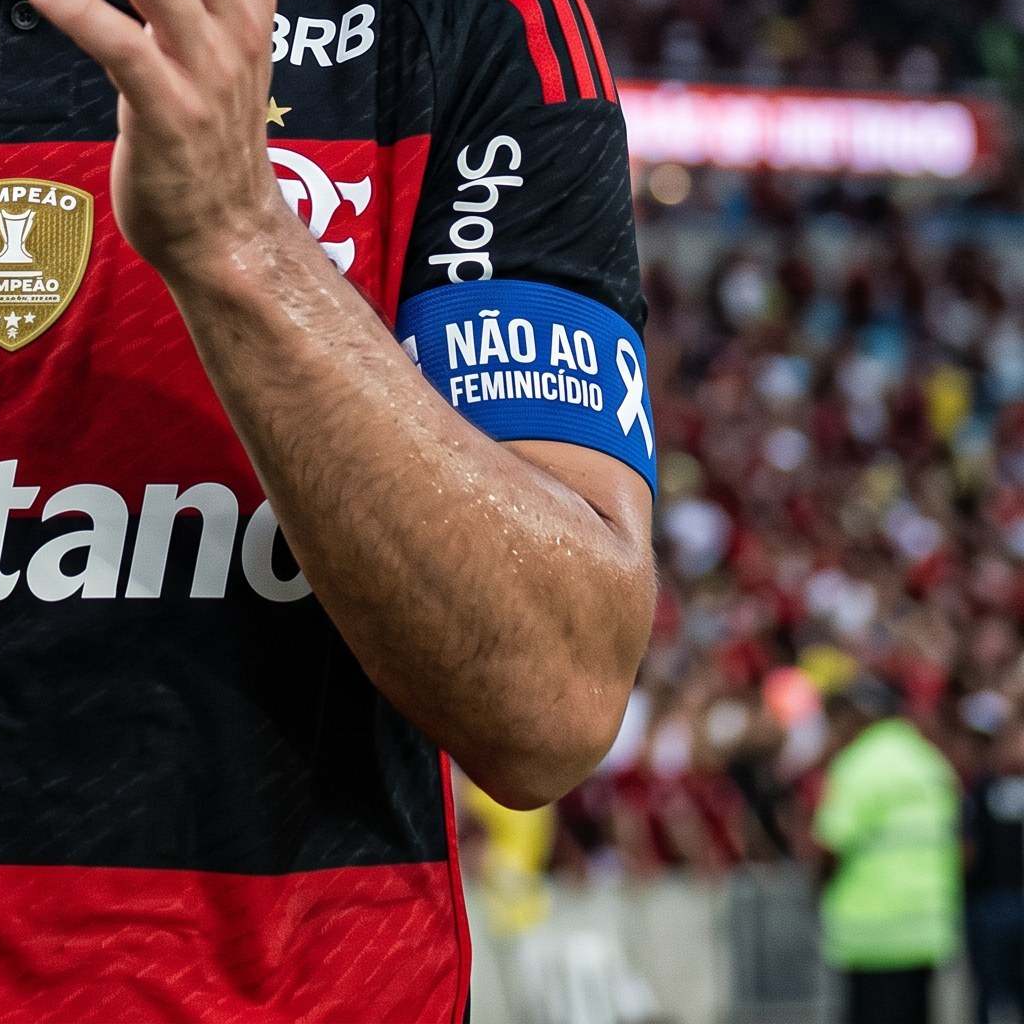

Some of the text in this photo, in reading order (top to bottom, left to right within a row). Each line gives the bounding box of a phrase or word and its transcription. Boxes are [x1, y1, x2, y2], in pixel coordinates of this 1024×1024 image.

[445, 309, 598, 375] NÃO AO
[449, 368, 603, 412] FEMINICÍDIO
